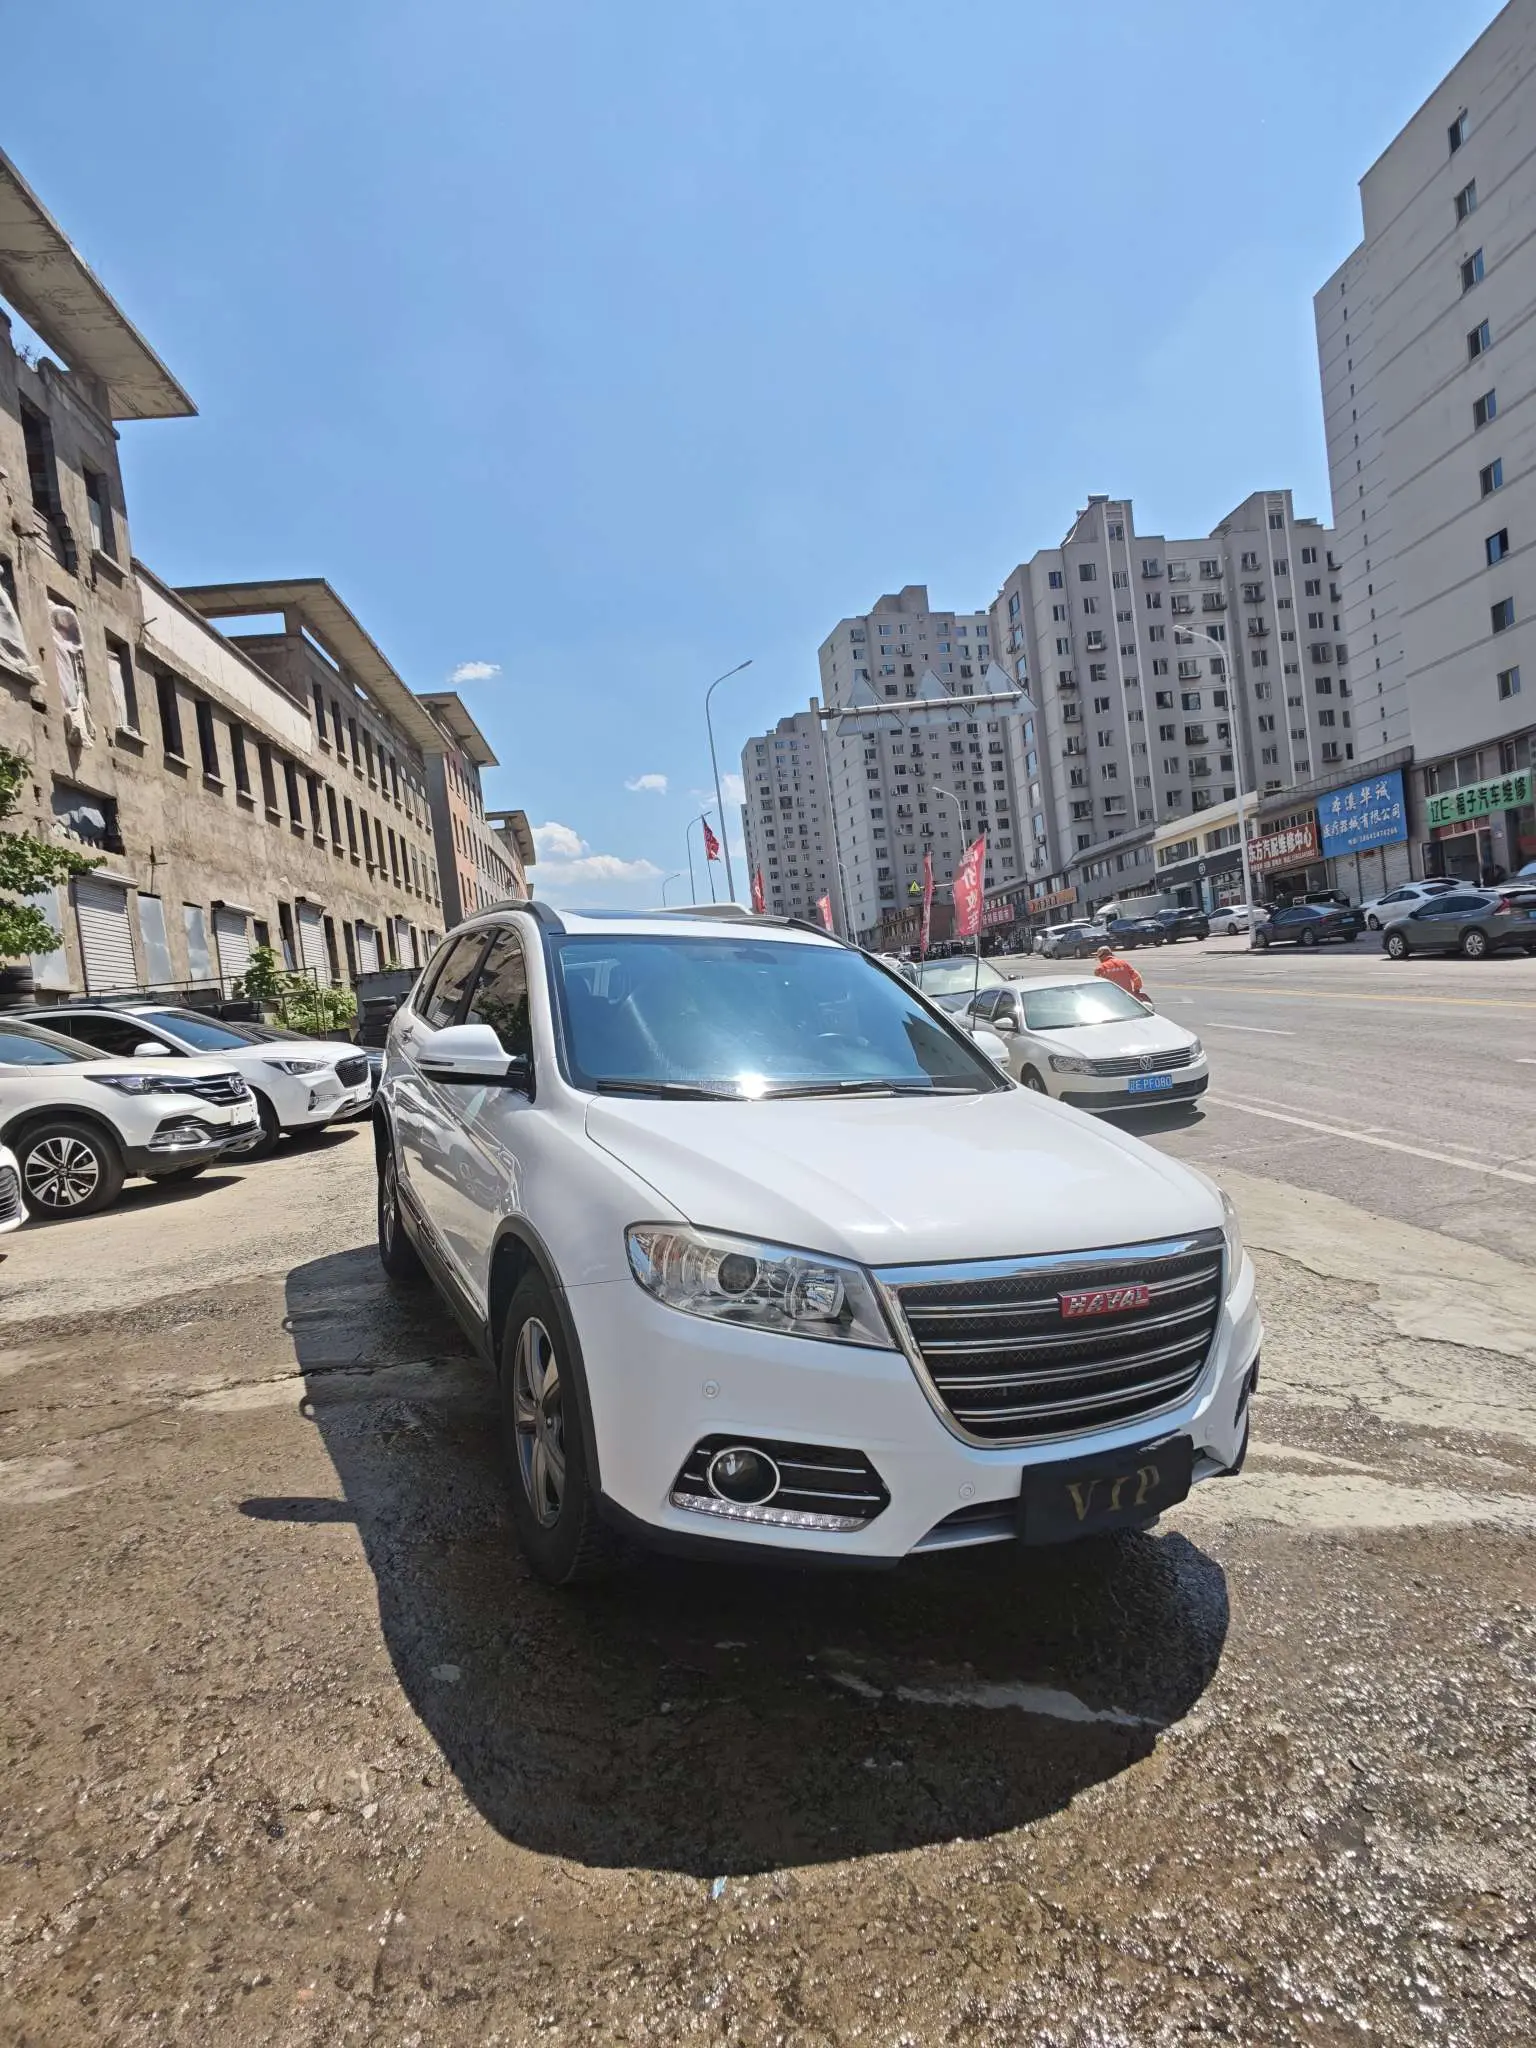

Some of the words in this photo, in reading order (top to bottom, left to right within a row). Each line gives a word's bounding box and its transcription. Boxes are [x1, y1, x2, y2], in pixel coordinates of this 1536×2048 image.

[1322, 803, 1401, 839] 医疗器械有限公司
[1068, 1288, 1149, 1315] HAVAL
[1065, 1464, 1161, 1521] VIP
